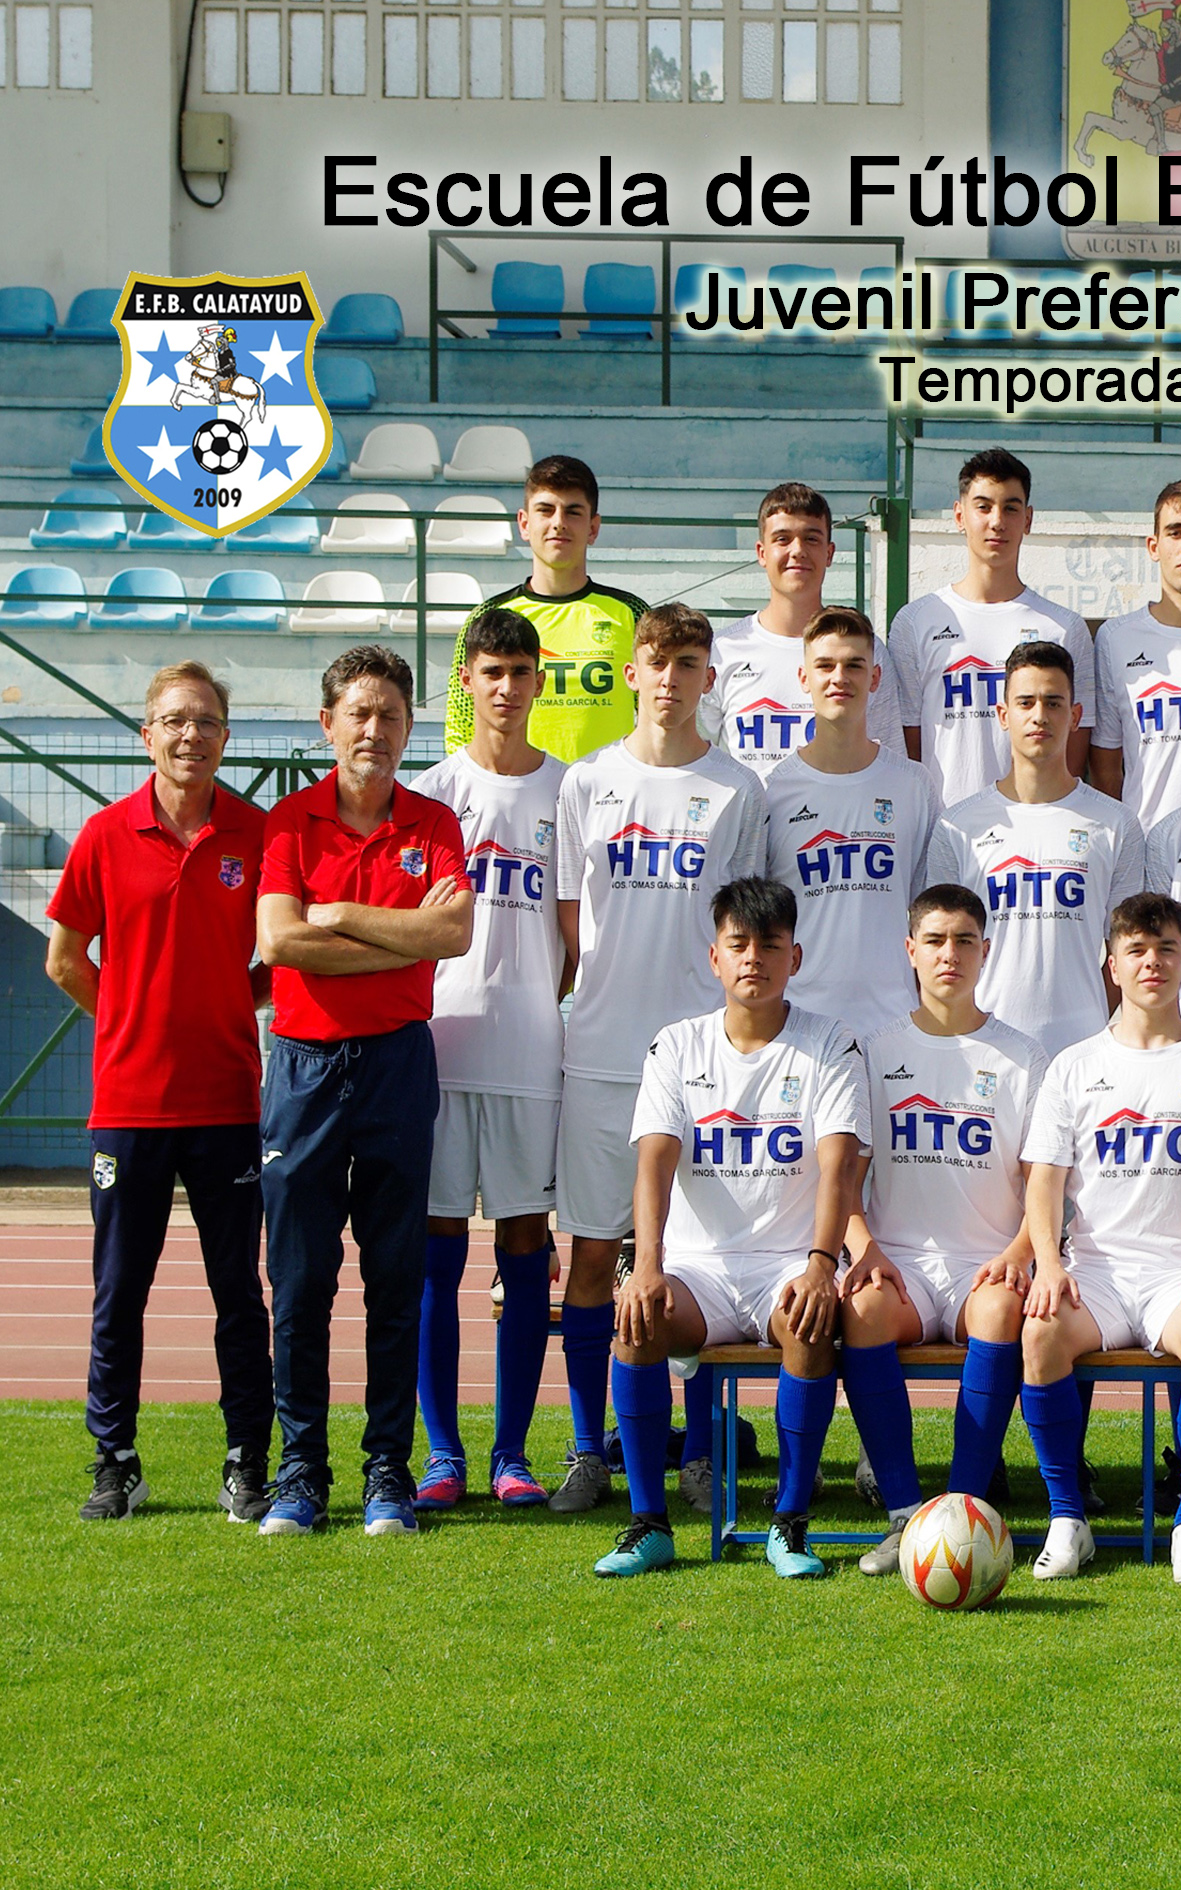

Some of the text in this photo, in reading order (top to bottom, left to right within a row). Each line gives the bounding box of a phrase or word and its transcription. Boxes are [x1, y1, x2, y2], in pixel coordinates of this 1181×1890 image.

[1083, 238, 1158, 255] AUGUSTA
[545, 661, 613, 695] TG
[943, 673, 1006, 708] HT
[535, 699, 564, 707] TOMAS
[970, 711, 995, 719] TOMAS
[607, 841, 706, 878] HTG
[797, 844, 894, 886] HTG
[465, 858, 544, 900] HTG
[826, 883, 850, 893] TOMAS
[987, 872, 1085, 911] HTG
[1013, 911, 1041, 920] TOMAS
[693, 1125, 803, 1165] HTG
[890, 1113, 992, 1156] HTG
[692, 1168, 718, 1178] HNOS.
[720, 1169, 750, 1178] TOMAS
[752, 1168, 789, 1177] GARCIA,
[914, 1155, 942, 1164] TOMAS
